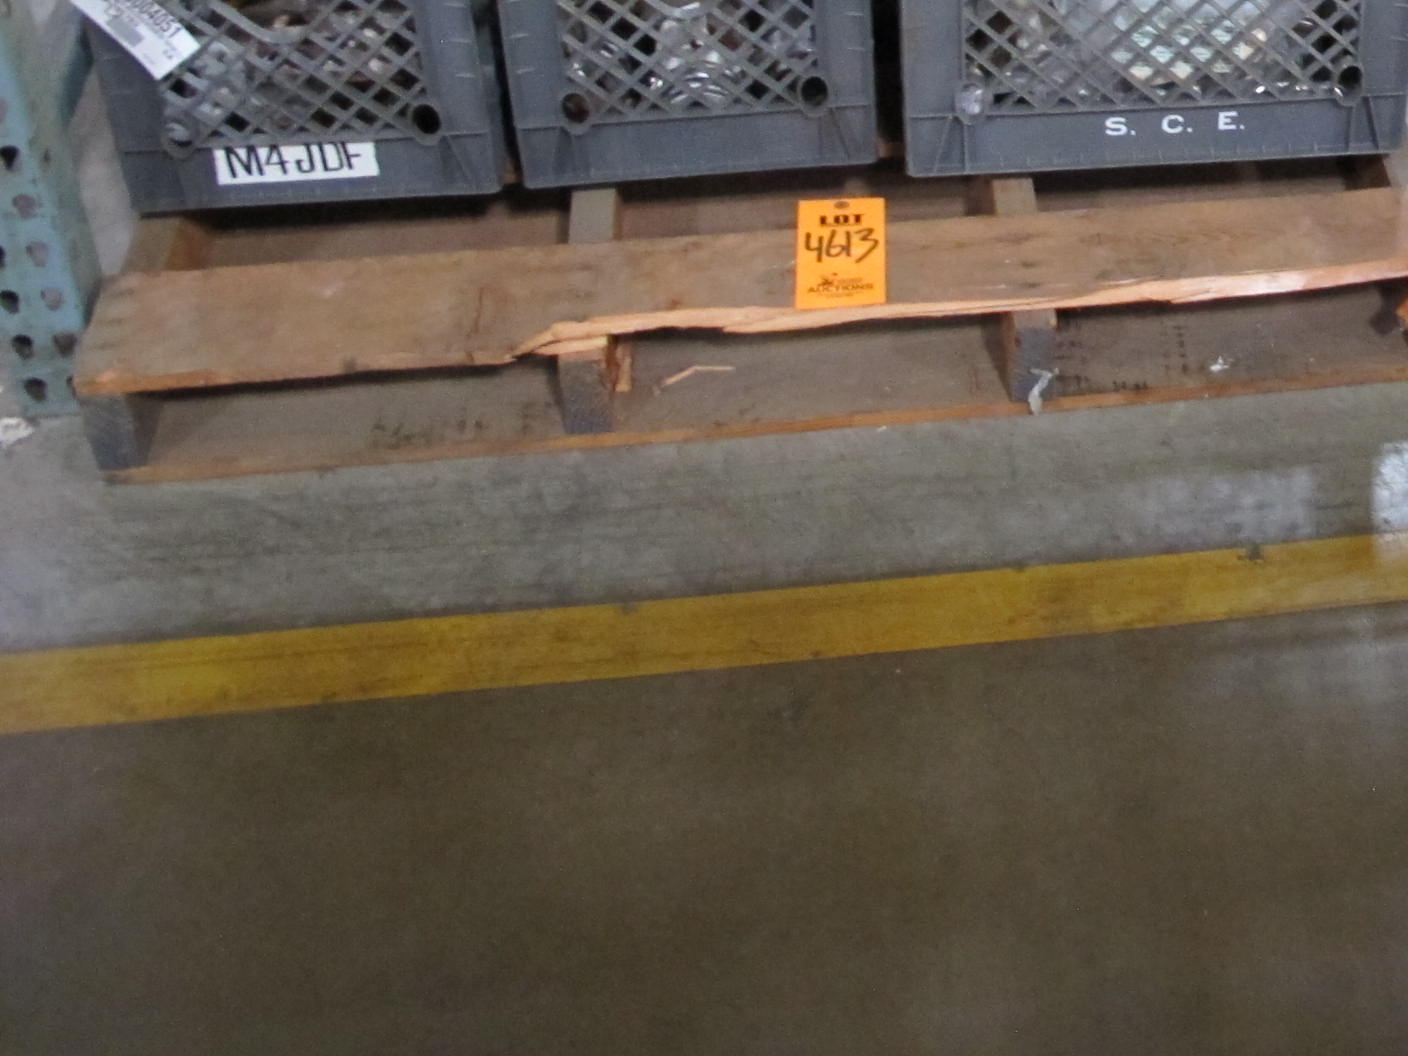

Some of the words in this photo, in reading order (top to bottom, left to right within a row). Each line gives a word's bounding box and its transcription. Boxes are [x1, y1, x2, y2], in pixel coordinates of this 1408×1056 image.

[1104, 116, 1136, 136] S.
[1161, 114, 1193, 134] C.
[1217, 110, 1245, 131] E.
[820, 214, 864, 226] LOT
[804, 227, 879, 263] 4613
